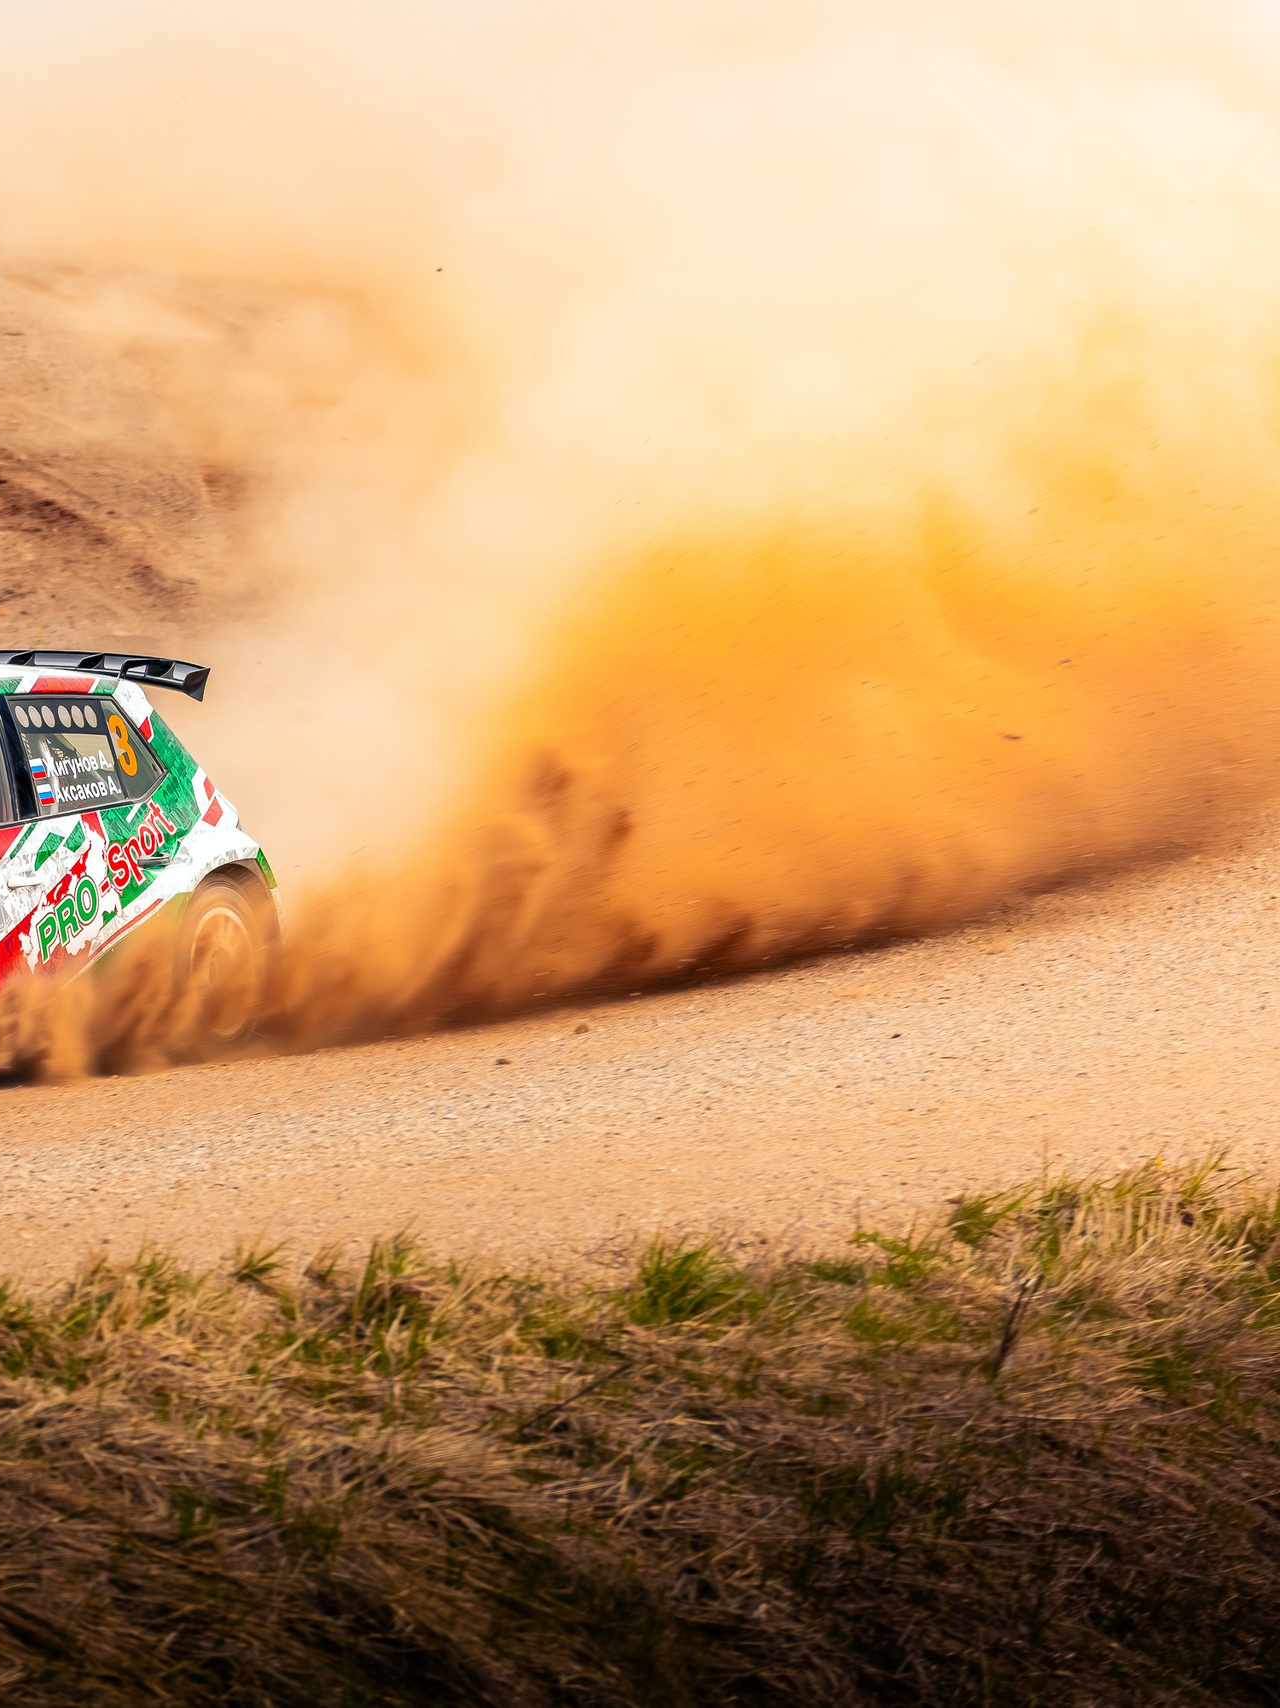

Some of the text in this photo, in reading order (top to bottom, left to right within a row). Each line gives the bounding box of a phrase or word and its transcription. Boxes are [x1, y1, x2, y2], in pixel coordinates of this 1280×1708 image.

[108, 714, 138, 777] 3
[42, 756, 99, 779] Жигунов
[54, 781, 108, 803] Аксаков
